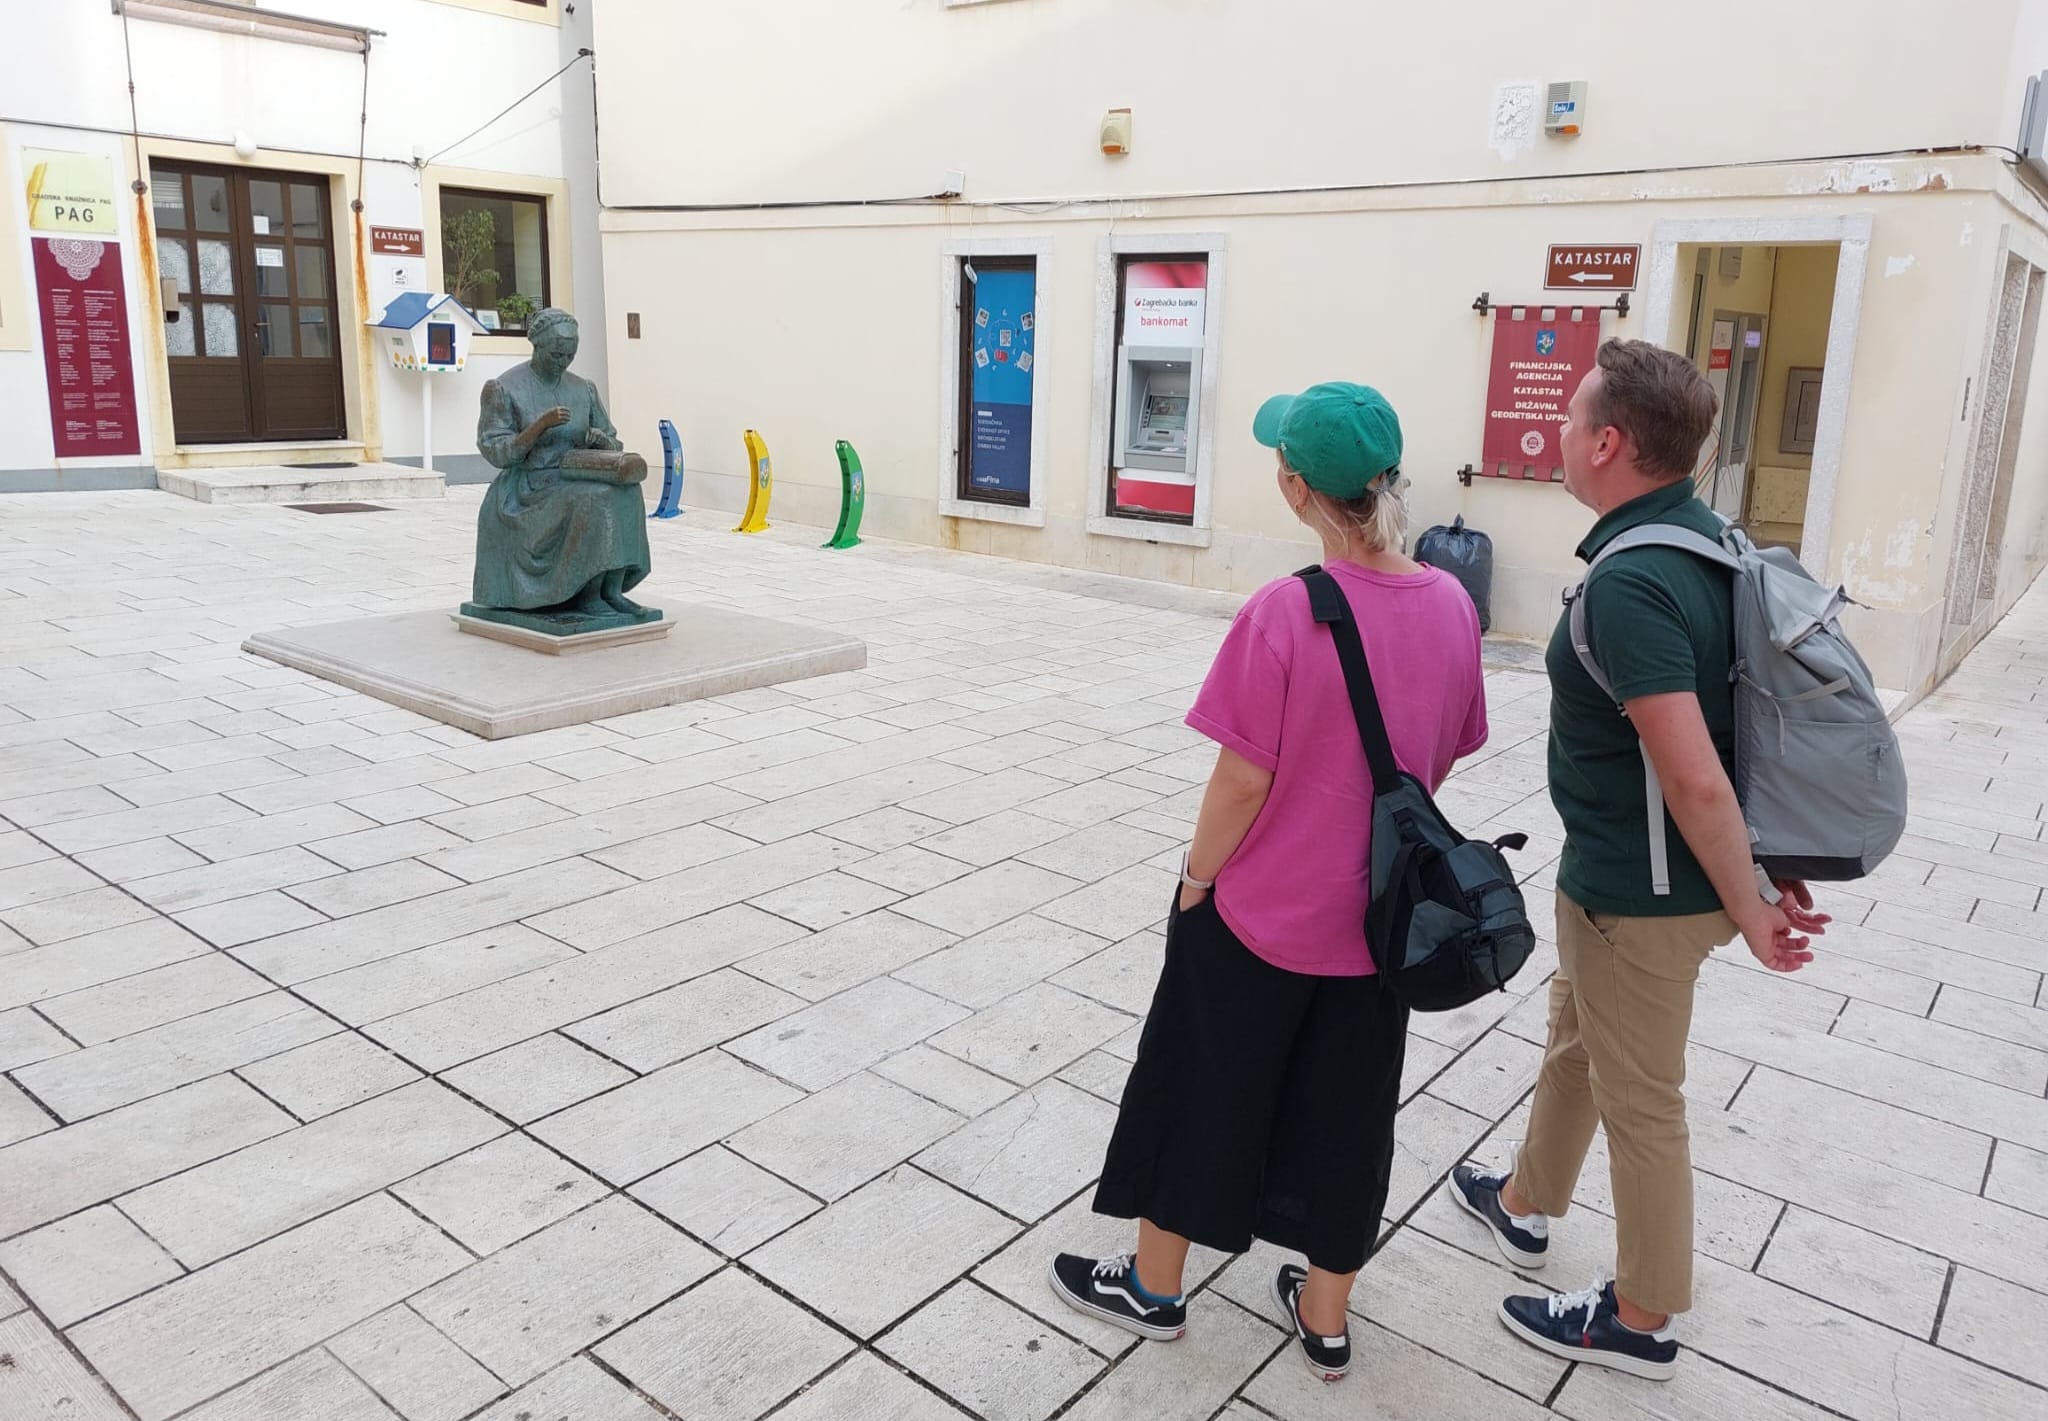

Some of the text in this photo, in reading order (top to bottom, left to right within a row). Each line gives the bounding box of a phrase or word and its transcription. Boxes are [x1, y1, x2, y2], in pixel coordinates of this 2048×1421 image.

[54, 205, 95, 223] PAG
[374, 231, 420, 242] KATASTAR
[1554, 252, 1632, 265] KATASTAR
[1178, 298, 1198, 307] banka
[1140, 315, 1188, 327] bankomat
[1509, 362, 1572, 372] FINANCIJSKA
[1516, 372, 1563, 382] AGENCIJA
[1513, 386, 1563, 396] KATASTAR
[1515, 400, 1558, 411] DRŽAVNA
[1491, 410, 1570, 421] GEODETSKA UPRA
